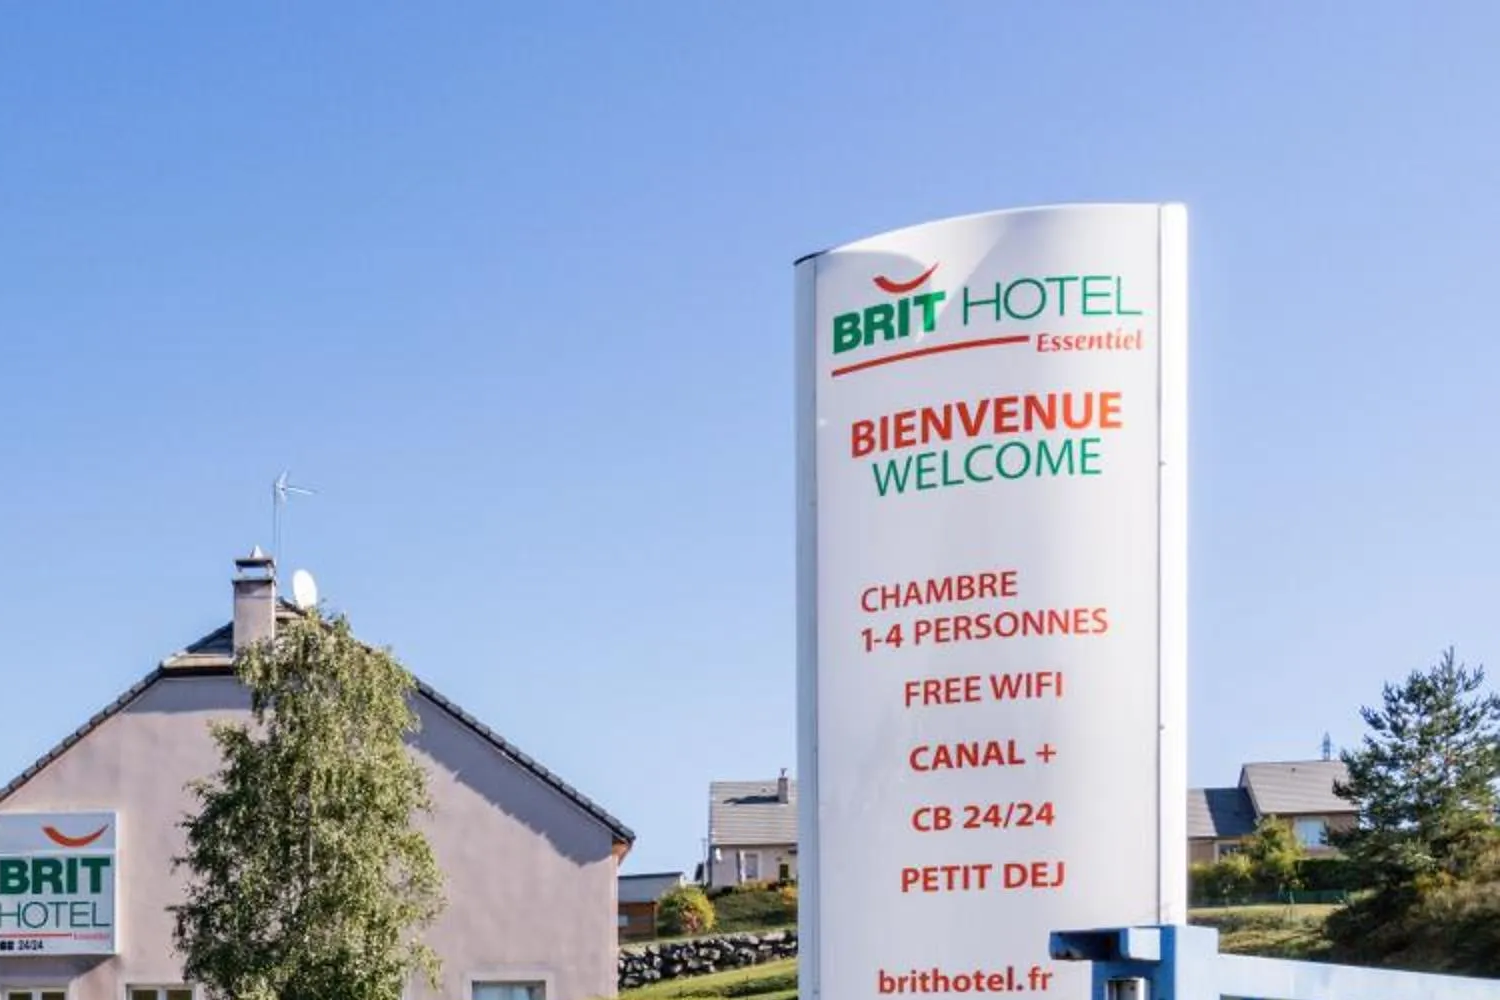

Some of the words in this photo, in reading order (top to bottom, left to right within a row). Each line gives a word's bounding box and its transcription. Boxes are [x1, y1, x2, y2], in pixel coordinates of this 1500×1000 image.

[831, 290, 947, 355] BRIT
[961, 274, 1144, 326] HOTEL
[1035, 328, 1145, 354] Essentiel
[850, 391, 1124, 459] BIENVENUE
[871, 437, 1103, 497] WELCOME
[860, 570, 1019, 613] CHAMBRE
[860, 623, 904, 653] 1-4
[913, 607, 1109, 646] PERSONNES
[903, 675, 982, 707] FREE
[988, 671, 1064, 700] WIFI
[908, 739, 1026, 773] CANAL
[1035, 744, 1057, 765] +
[910, 805, 953, 833] CB
[963, 800, 1055, 830] 24/24
[900, 863, 993, 894] PETIT
[1002, 861, 1066, 890] DEJ
[877, 965, 1054, 995] brithotel.fr
